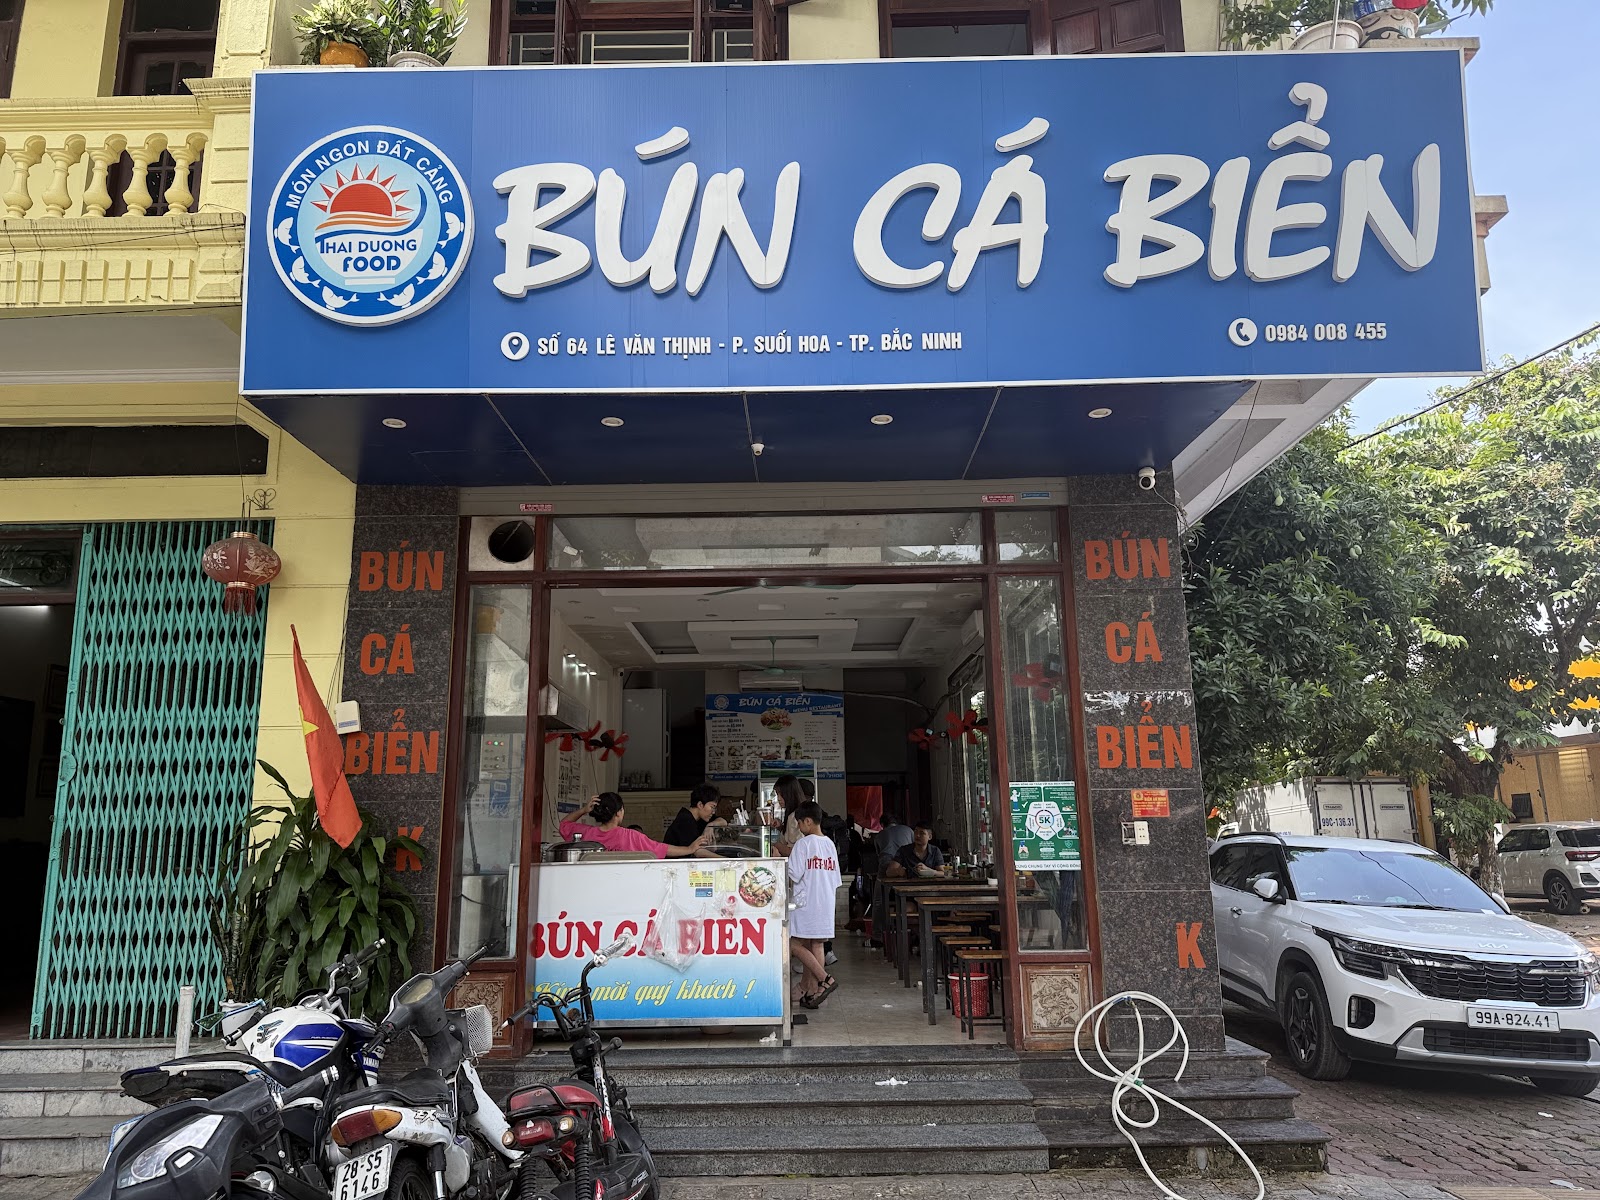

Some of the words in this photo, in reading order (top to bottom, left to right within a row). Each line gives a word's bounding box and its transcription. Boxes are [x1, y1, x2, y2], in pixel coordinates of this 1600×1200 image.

[285, 168, 317, 209] MÓN
[315, 140, 370, 171] NGON
[376, 138, 416, 161] ĐẤT
[416, 158, 454, 205] CẢNG
[491, 125, 801, 299] BÚN
[852, 116, 1050, 292] CÁ
[1103, 81, 1442, 288] BIỂN
[315, 235, 352, 255] THAI
[358, 239, 418, 254] DUONG
[342, 255, 402, 273] FOOD
[537, 333, 559, 355] SỐ
[566, 337, 588, 355] 64
[596, 335, 616, 355] LÊ
[622, 332, 656, 355] VĂN
[661, 336, 712, 360] THỊNH
[732, 335, 748, 354] P.
[753, 329, 792, 354] SUỐI
[798, 335, 832, 353] HOA
[848, 334, 874, 353] TP.
[880, 330, 913, 351] BẮC
[921, 331, 963, 350] NINH
[1264, 324, 1309, 342] 0984
[1314, 323, 1348, 341] 008
[1355, 322, 1387, 340] 455
[358, 540, 445, 592] BÚN
[1084, 530, 1171, 580] BÚN
[360, 623, 415, 676] CÁ
[1105, 612, 1163, 663] CÁ
[738, 696, 763, 707] BÚN
[765, 695, 782, 706] CÁ
[344, 708, 440, 776] BIỂN
[1096, 701, 1193, 770] BIỂN
[1038, 816, 1051, 824] 5K
[395, 826, 425, 872] K
[530, 911, 603, 959] BÚN
[1176, 922, 1207, 969] K
[591, 980, 632, 1002] mời
[633, 979, 674, 1007] quý
[676, 978, 737, 1002] khách
[743, 978, 757, 999] !
[1475, 1010, 1551, 1028] 99A-824.41
[340, 1171, 380, 1200] 6146
[342, 1149, 383, 1183] 28-S5
